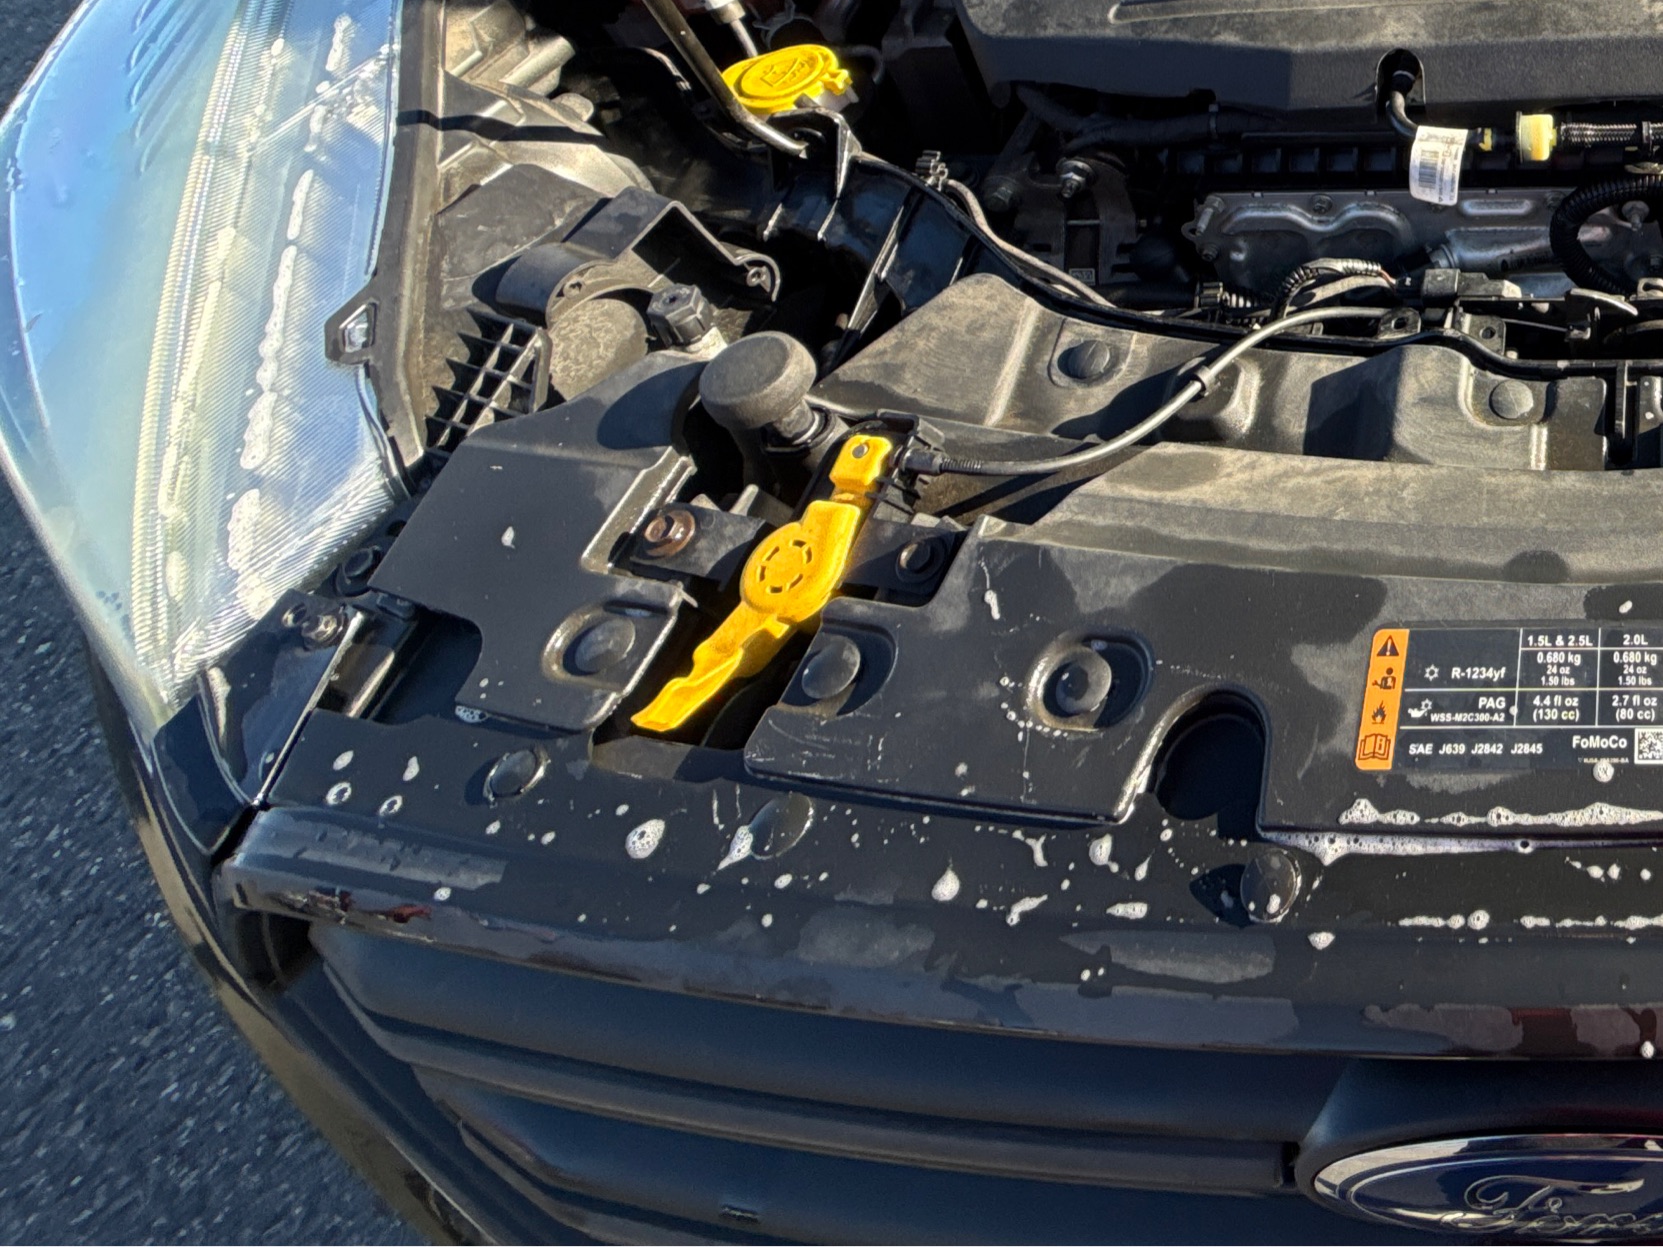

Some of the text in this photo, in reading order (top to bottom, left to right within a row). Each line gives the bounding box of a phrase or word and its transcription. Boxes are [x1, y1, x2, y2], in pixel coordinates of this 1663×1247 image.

[1527, 635, 1594, 647] 1.5L & 2.5L
[1622, 634, 1649, 646] 2.0L
[1536, 652, 1582, 666] 0.680 kg
[1613, 652, 1658, 666] 0.680 kg
[1451, 666, 1506, 682] R-1234yf
[1546, 666, 1557, 674] 24
[1623, 666, 1634, 674] 24
[1540, 676, 1576, 685] 1.50 lbs
[1617, 676, 1653, 685] 1.50 lbs
[1478, 697, 1506, 709] PAG
[1533, 695, 1579, 706] 4.4 fl oz
[1612, 695, 1658, 706] 2.7 fl oz
[1533, 708, 1580, 722] (130 cc)
[1616, 708, 1656, 722] (80 cc)
[1572, 735, 1628, 748] FoMoCo
[1409, 743, 1543, 754] SAE J639 J2842 J2845
